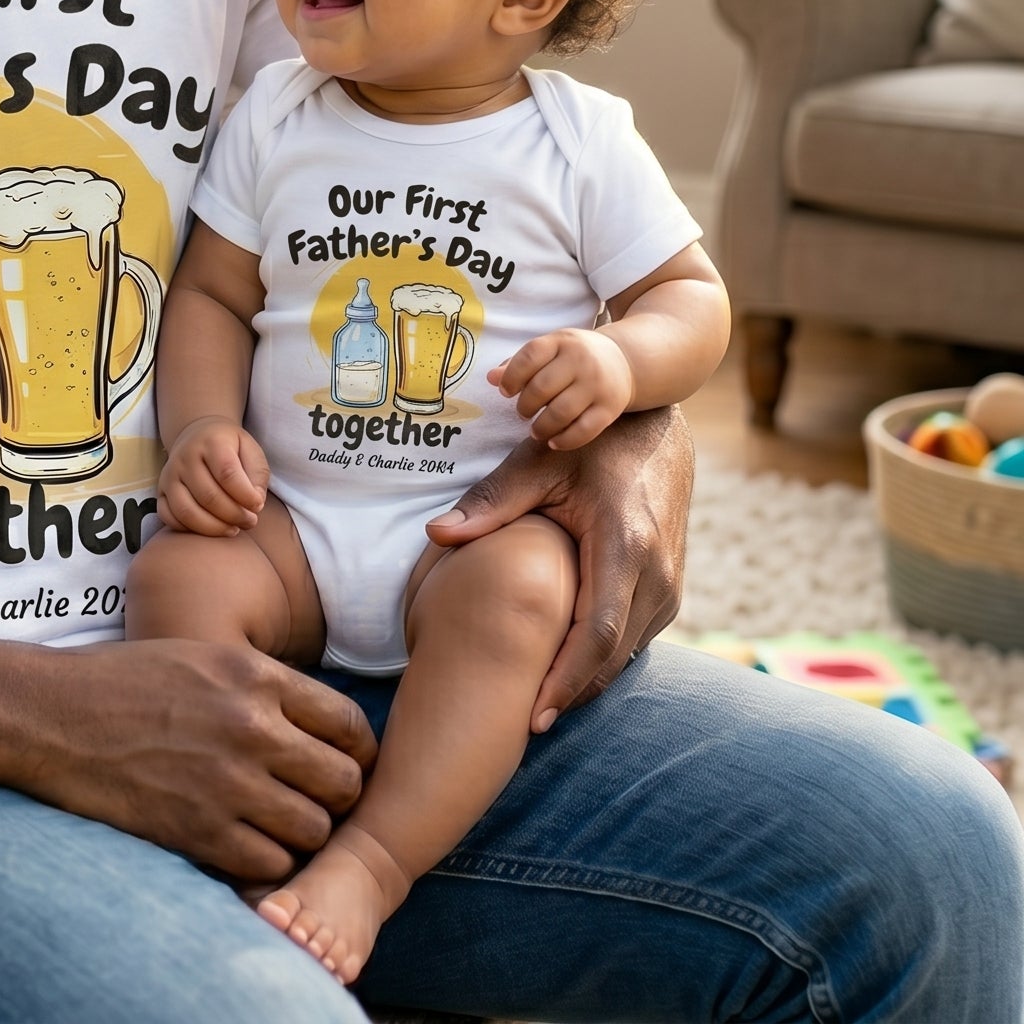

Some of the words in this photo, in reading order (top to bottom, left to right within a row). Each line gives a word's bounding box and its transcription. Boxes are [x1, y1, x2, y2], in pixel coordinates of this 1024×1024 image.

[66, 43, 216, 164] Day
[328, 184, 395, 218] Our
[405, 184, 487, 232] First
[445, 236, 515, 294] Day
[307, 404, 462, 451] together
[308, 448, 352, 469] Daddy
[355, 453, 364, 466] &
[367, 454, 415, 471] Charlie
[80, 584, 126, 616] 20
